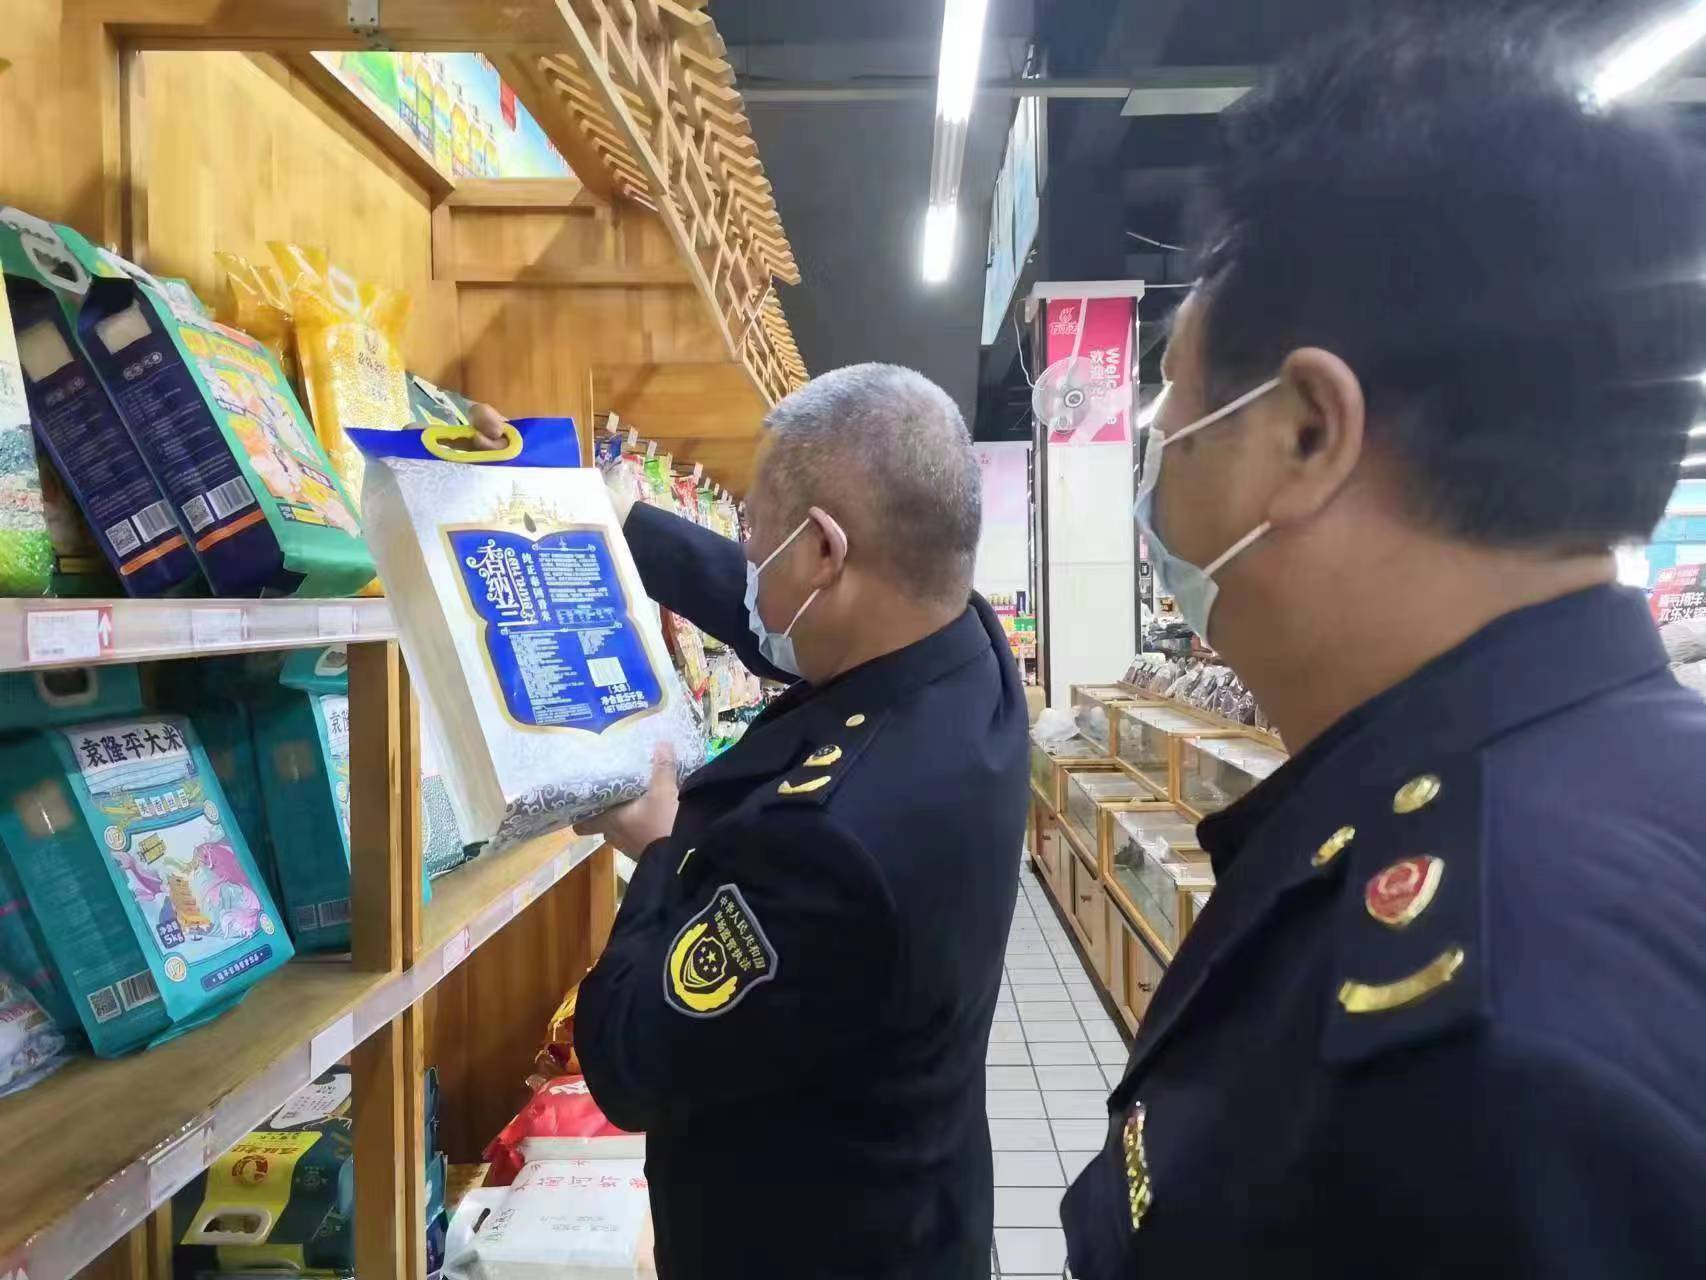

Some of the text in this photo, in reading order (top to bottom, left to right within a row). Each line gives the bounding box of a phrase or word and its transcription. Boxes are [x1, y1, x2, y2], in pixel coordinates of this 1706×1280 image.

[1104, 347, 1121, 425] Welce
[80, 724, 184, 768] 袁隆平大米
[165, 930, 184, 946] 5kg
[713, 910, 752, 972] 市场监管执法
[719, 895, 766, 969] 中华人民共和国
